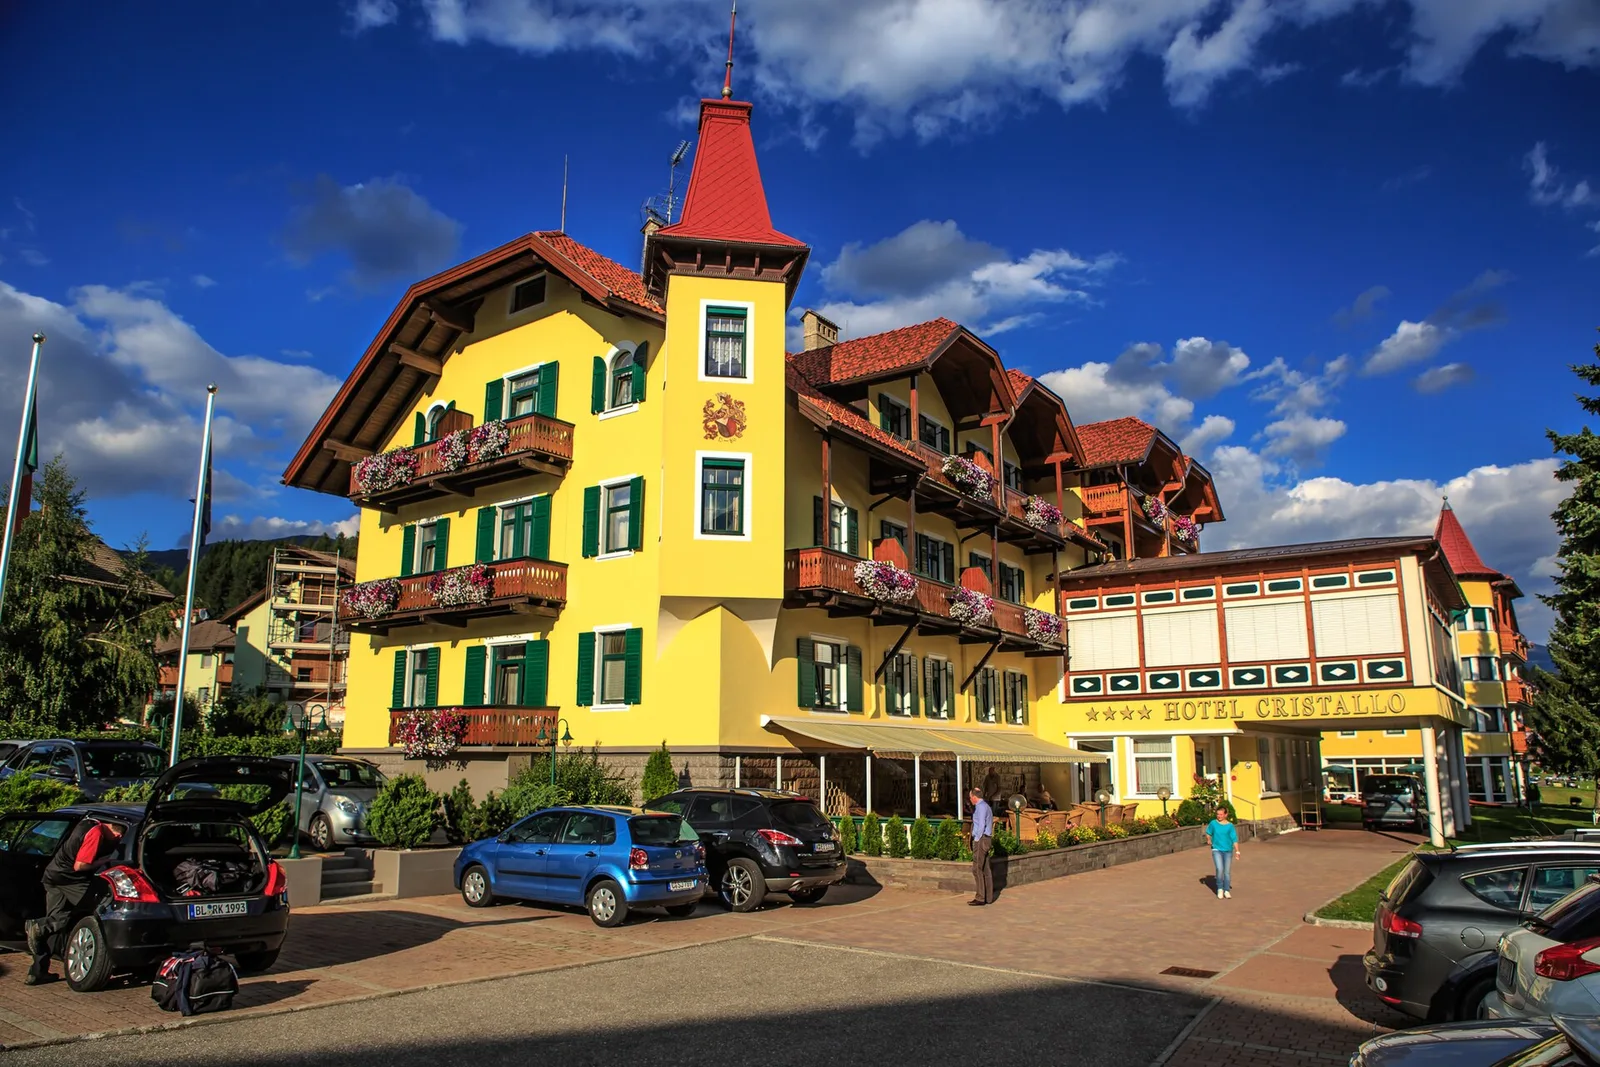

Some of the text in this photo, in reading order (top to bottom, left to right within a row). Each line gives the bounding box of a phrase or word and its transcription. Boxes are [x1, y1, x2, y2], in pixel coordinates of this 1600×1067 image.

[1163, 692, 1406, 721] HOTEL CRISTALLO
[195, 903, 246, 916] BL RK 1993
